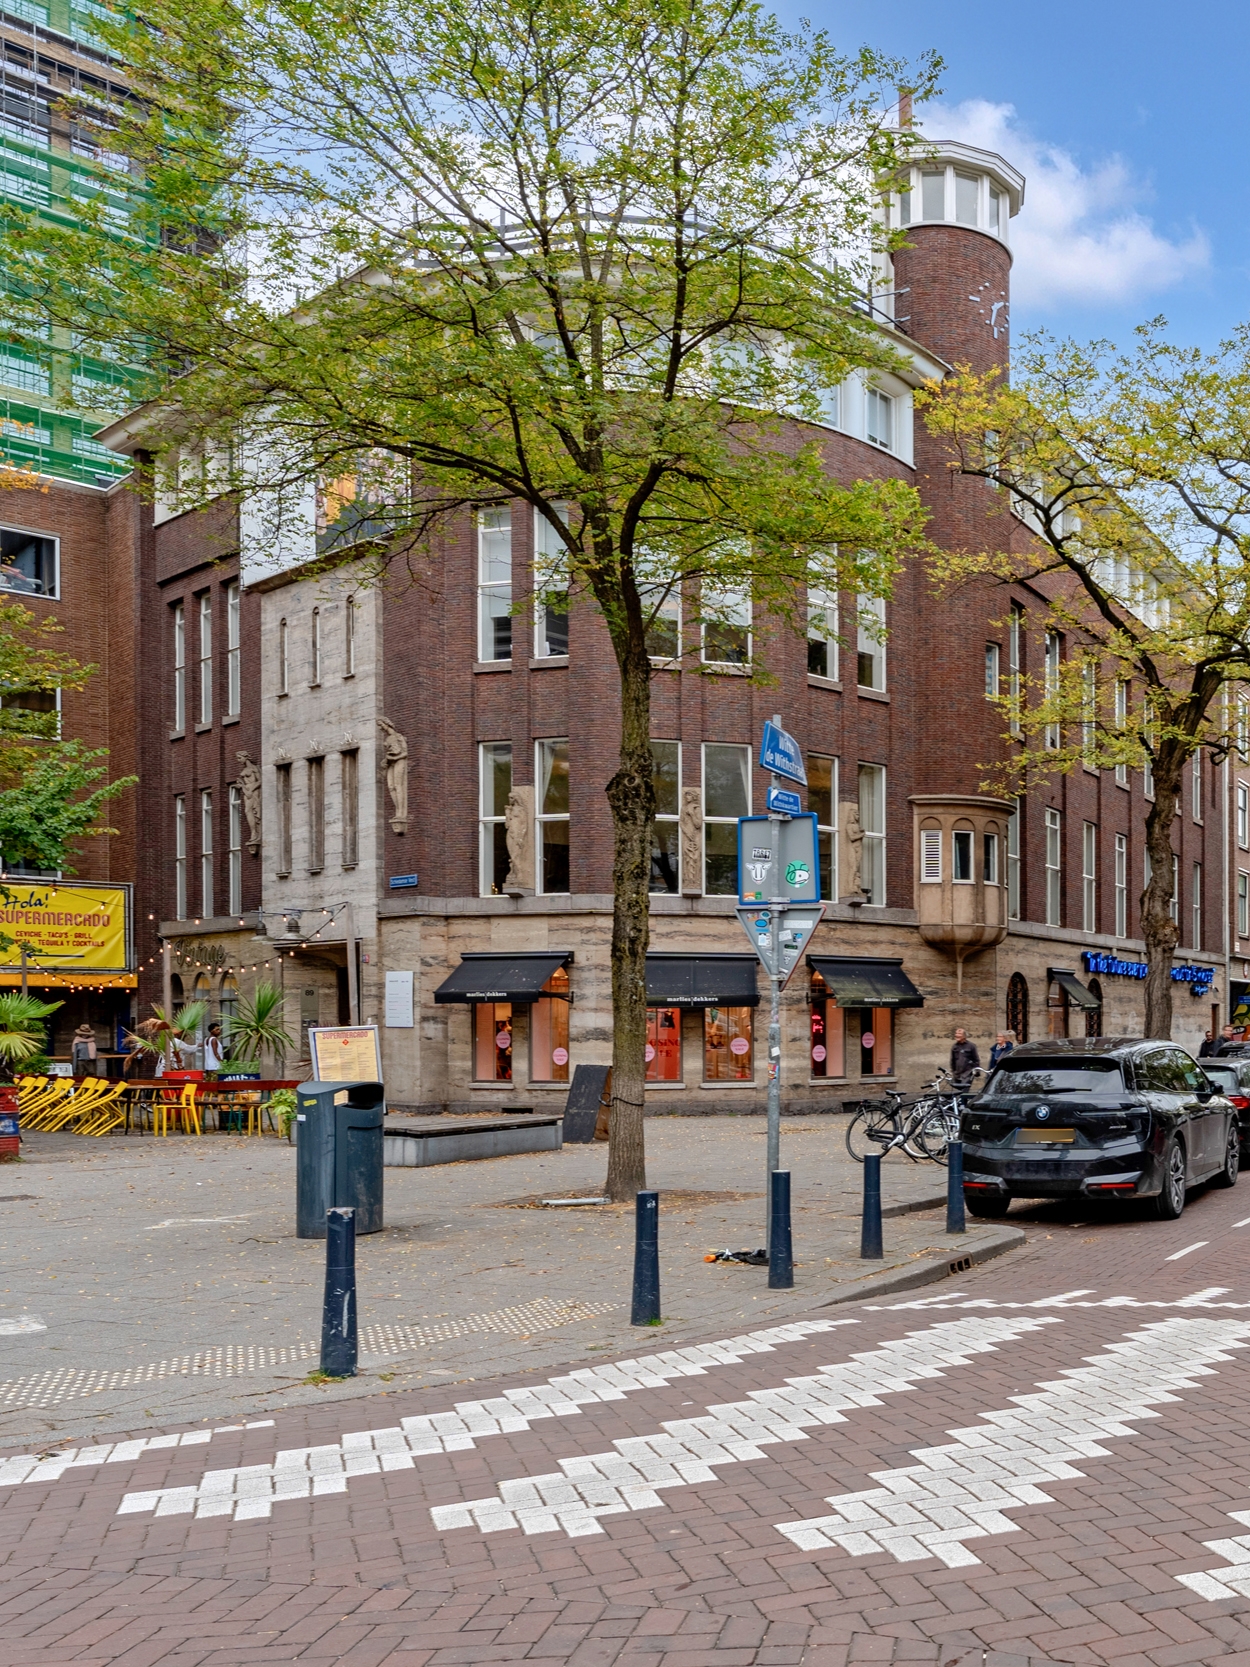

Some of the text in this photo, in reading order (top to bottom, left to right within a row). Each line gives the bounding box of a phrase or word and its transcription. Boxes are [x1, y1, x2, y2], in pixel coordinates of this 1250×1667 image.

[779, 736, 795, 755] Witte
[765, 749, 774, 764] de
[2, 891, 49, 910] Hola!
[0, 909, 111, 928] SUPERMERCADO
[15, 930, 42, 938] CEVICHE
[38, 939, 65, 947] TEQUILA
[72, 940, 106, 948] COCKTAILS
[322, 1031, 368, 1039] SUPERMERCADO
